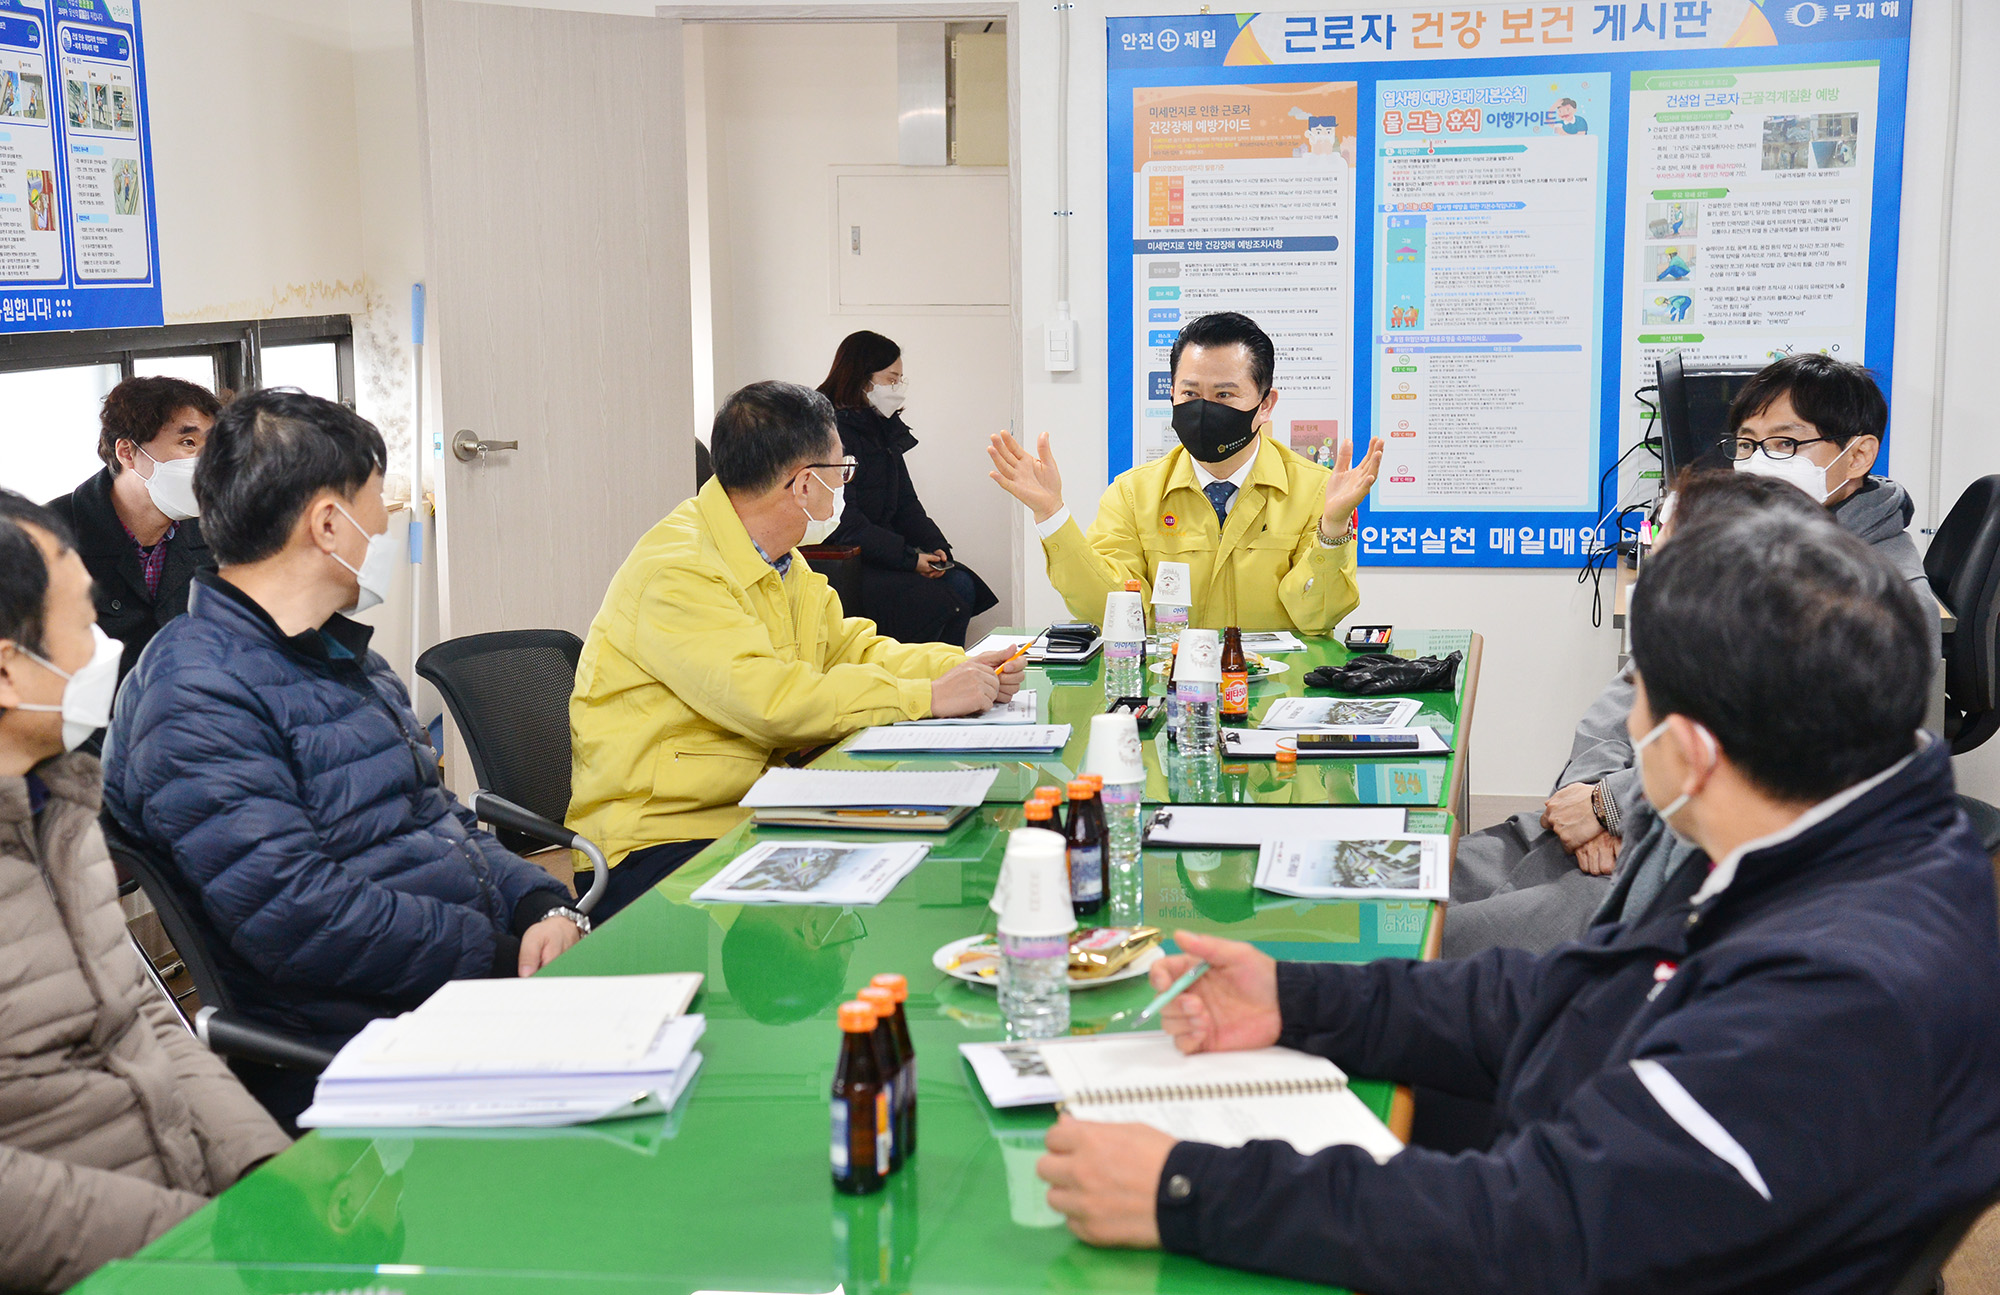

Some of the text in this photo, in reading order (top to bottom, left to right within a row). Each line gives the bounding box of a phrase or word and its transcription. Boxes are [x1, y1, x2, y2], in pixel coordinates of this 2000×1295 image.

[1833, 0, 1899, 20] 무재해
[1284, 3, 1712, 53] 근로자 건강 보건 게시판
[1121, 30, 1217, 51] 안전 제일
[1383, 86, 1527, 107] 열사병 예방 3대 기본수칙
[1666, 87, 1840, 108] 건설업 근로자 근골격계질환 예방
[1149, 105, 1251, 118] 미세먼지로 인한 근로자
[1383, 108, 1558, 134] 물 그늘 휴식 이행가이드
[1149, 119, 1251, 134] 건강장해 예방가이드
[1147, 239, 1283, 251] 미세먼지로 인한 건강장해 예방조치사항
[0, 298, 52, 322] 원합니다!
[1362, 526, 1475, 554] 안전실천
[1489, 527, 1606, 555] 매일매일
